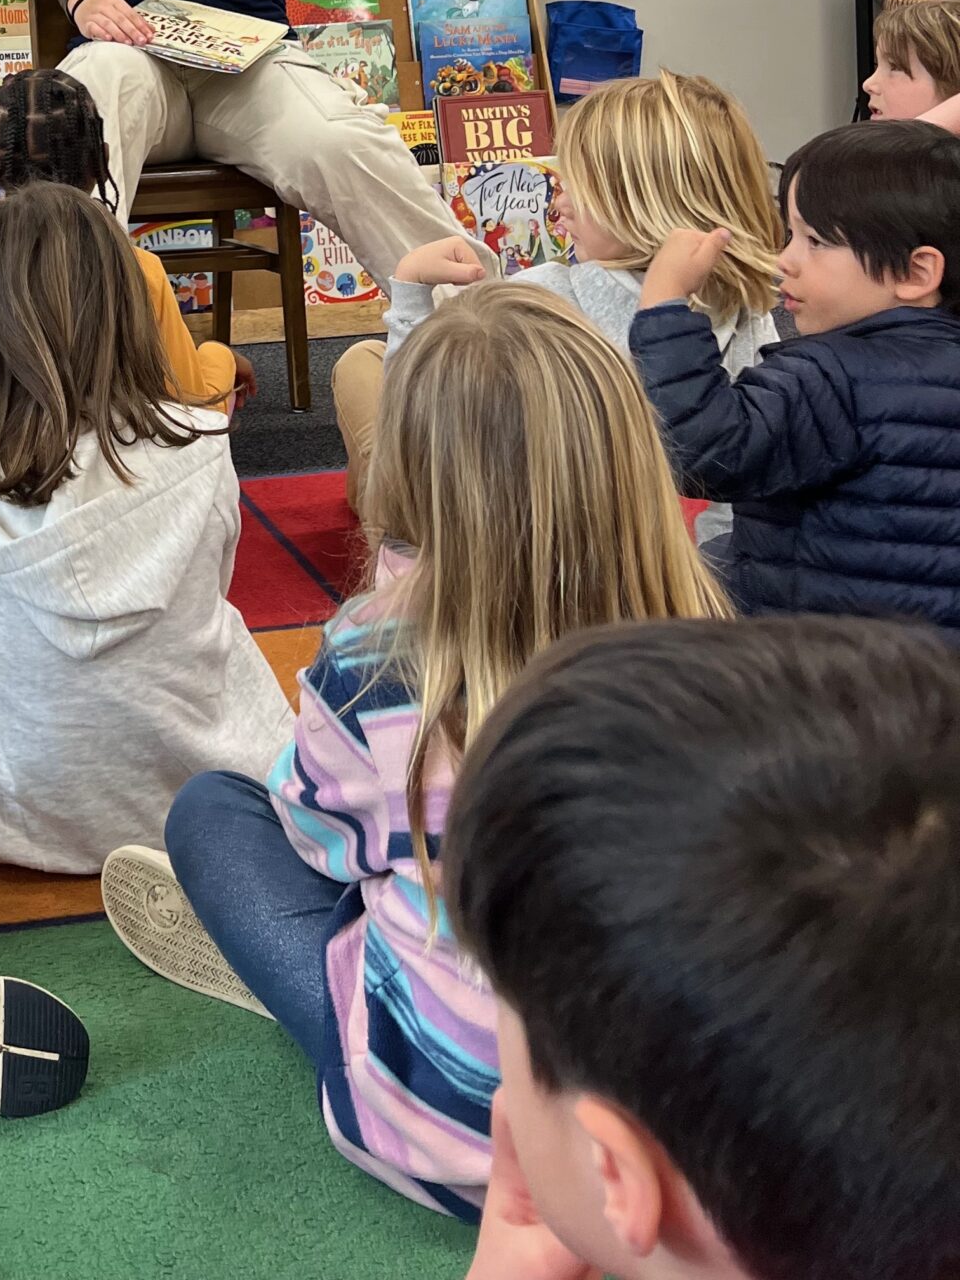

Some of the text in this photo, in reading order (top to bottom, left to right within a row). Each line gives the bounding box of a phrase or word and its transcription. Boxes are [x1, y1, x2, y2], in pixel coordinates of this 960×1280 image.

[461, 104, 531, 121] MARTIN'S
[462, 117, 533, 150] BIG
[465, 168, 548, 217] Two New
[495, 193, 542, 221] Years
